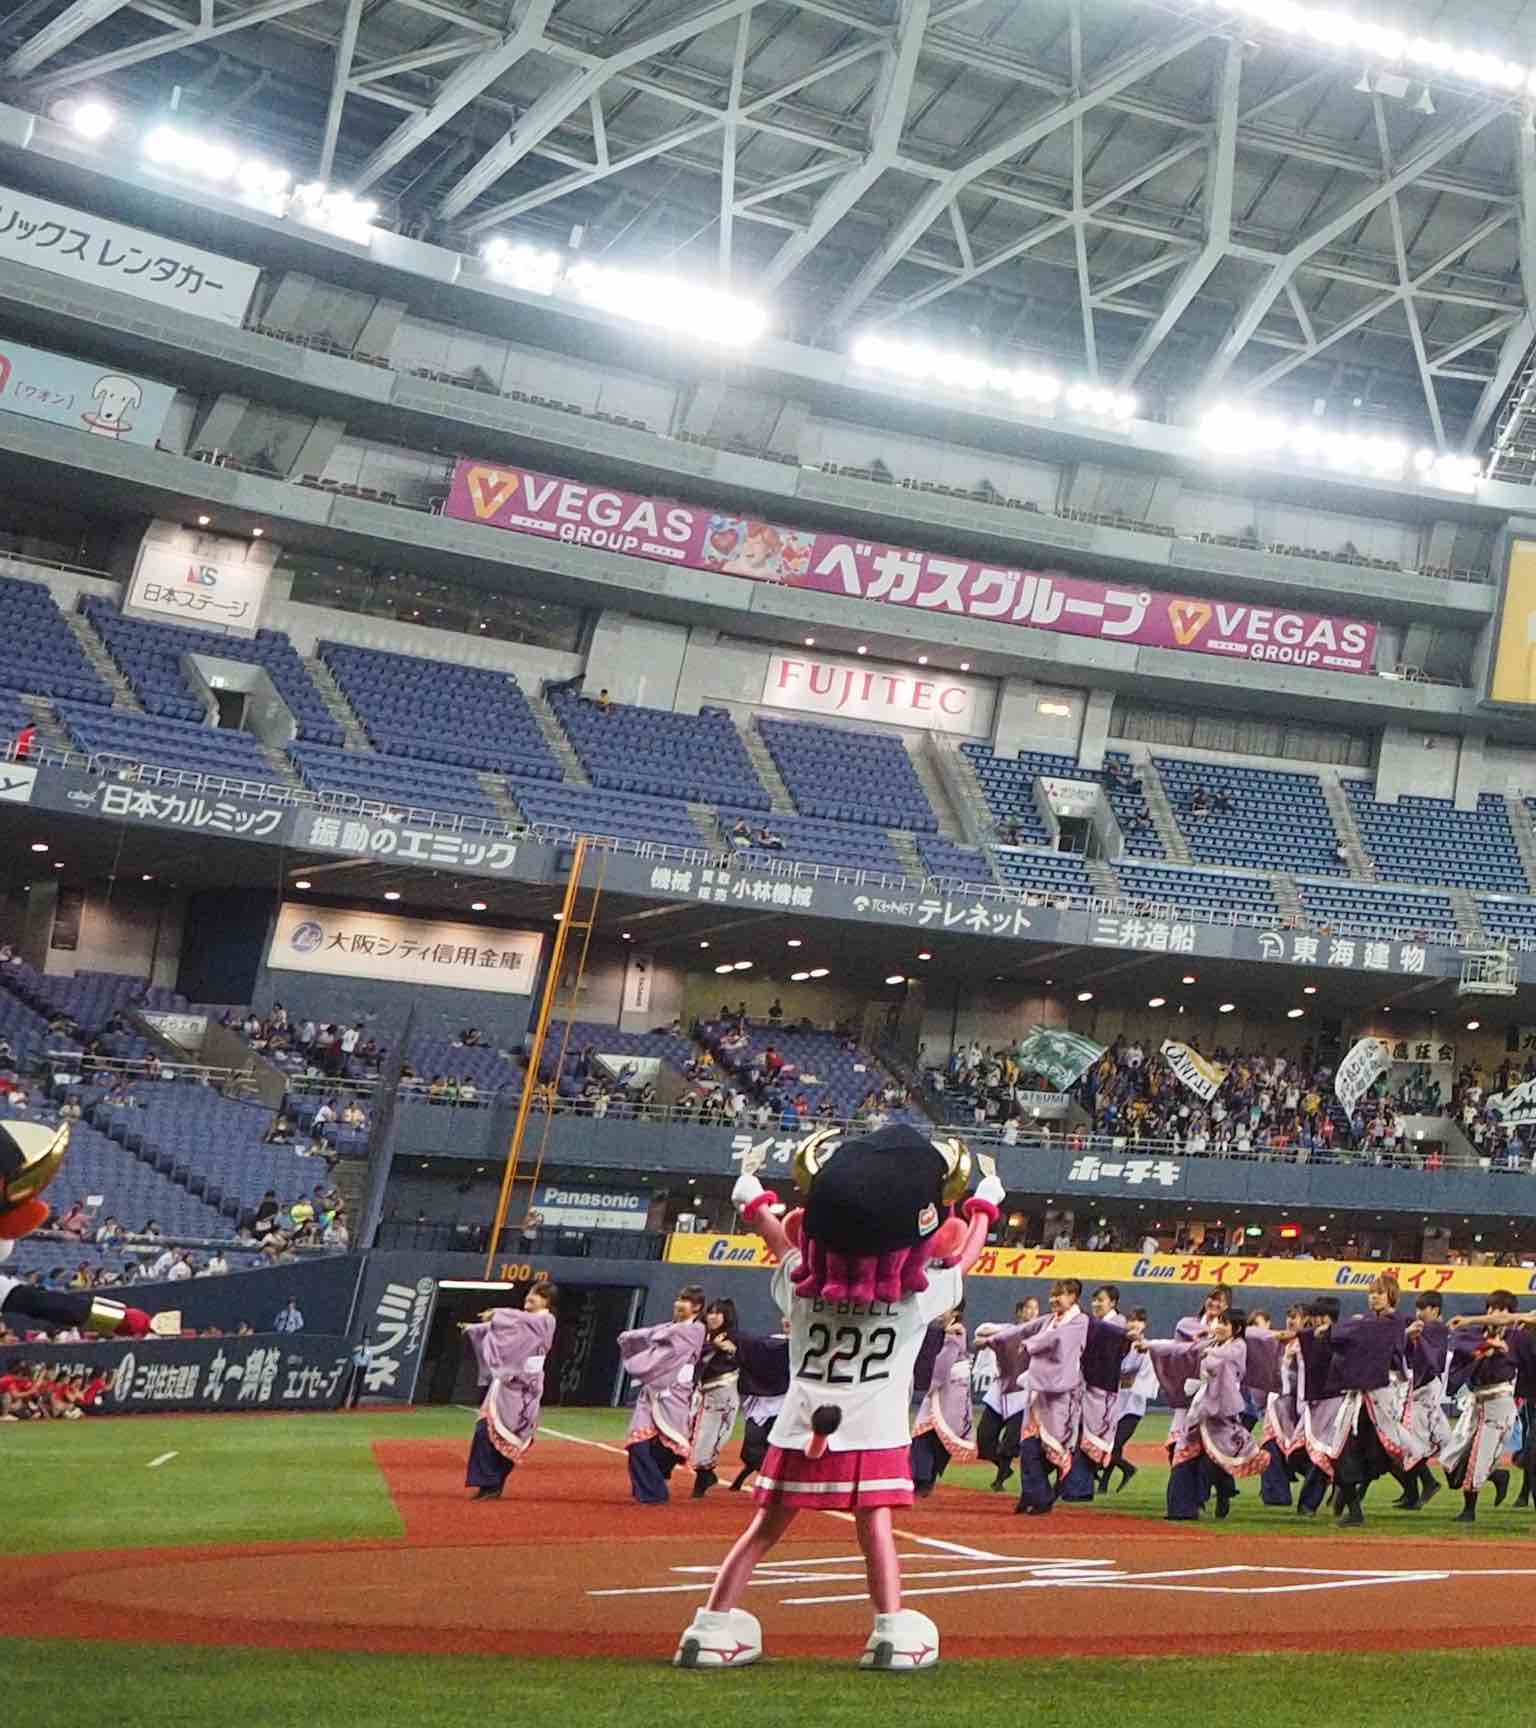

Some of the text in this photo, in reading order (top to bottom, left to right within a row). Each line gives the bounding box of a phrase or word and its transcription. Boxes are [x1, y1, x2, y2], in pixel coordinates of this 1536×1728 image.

[97, 240, 223, 294] レンタカー
[522, 479, 695, 545] VEGAS
[558, 522, 639, 553] GROUP
[143, 583, 249, 618] 日本ステージ
[814, 543, 1151, 638] ベガスグループ
[1214, 605, 1368, 653] VEGAS
[1250, 643, 1320, 667] GROUP
[775, 661, 969, 717] FUJITEC
[101, 784, 282, 836] 日本カルミック
[308, 817, 518, 870] 振動のエミック
[732, 878, 813, 908] 小林機械
[917, 899, 1032, 936] テレネット
[1092, 917, 1197, 953] 三井造船
[326, 931, 525, 971] 大阪シティ信用金庫
[1291, 936, 1426, 972] 東海建物
[1068, 1154, 1181, 1186] ホーチキ
[544, 1186, 640, 1210] Panasonic
[707, 1238, 756, 1262] GAIA
[975, 1251, 1056, 1275] ガイア
[499, 1263, 531, 1282] 100
[1132, 1256, 1260, 1284] GAIA ガイア
[796, 1323, 897, 1384] 222
